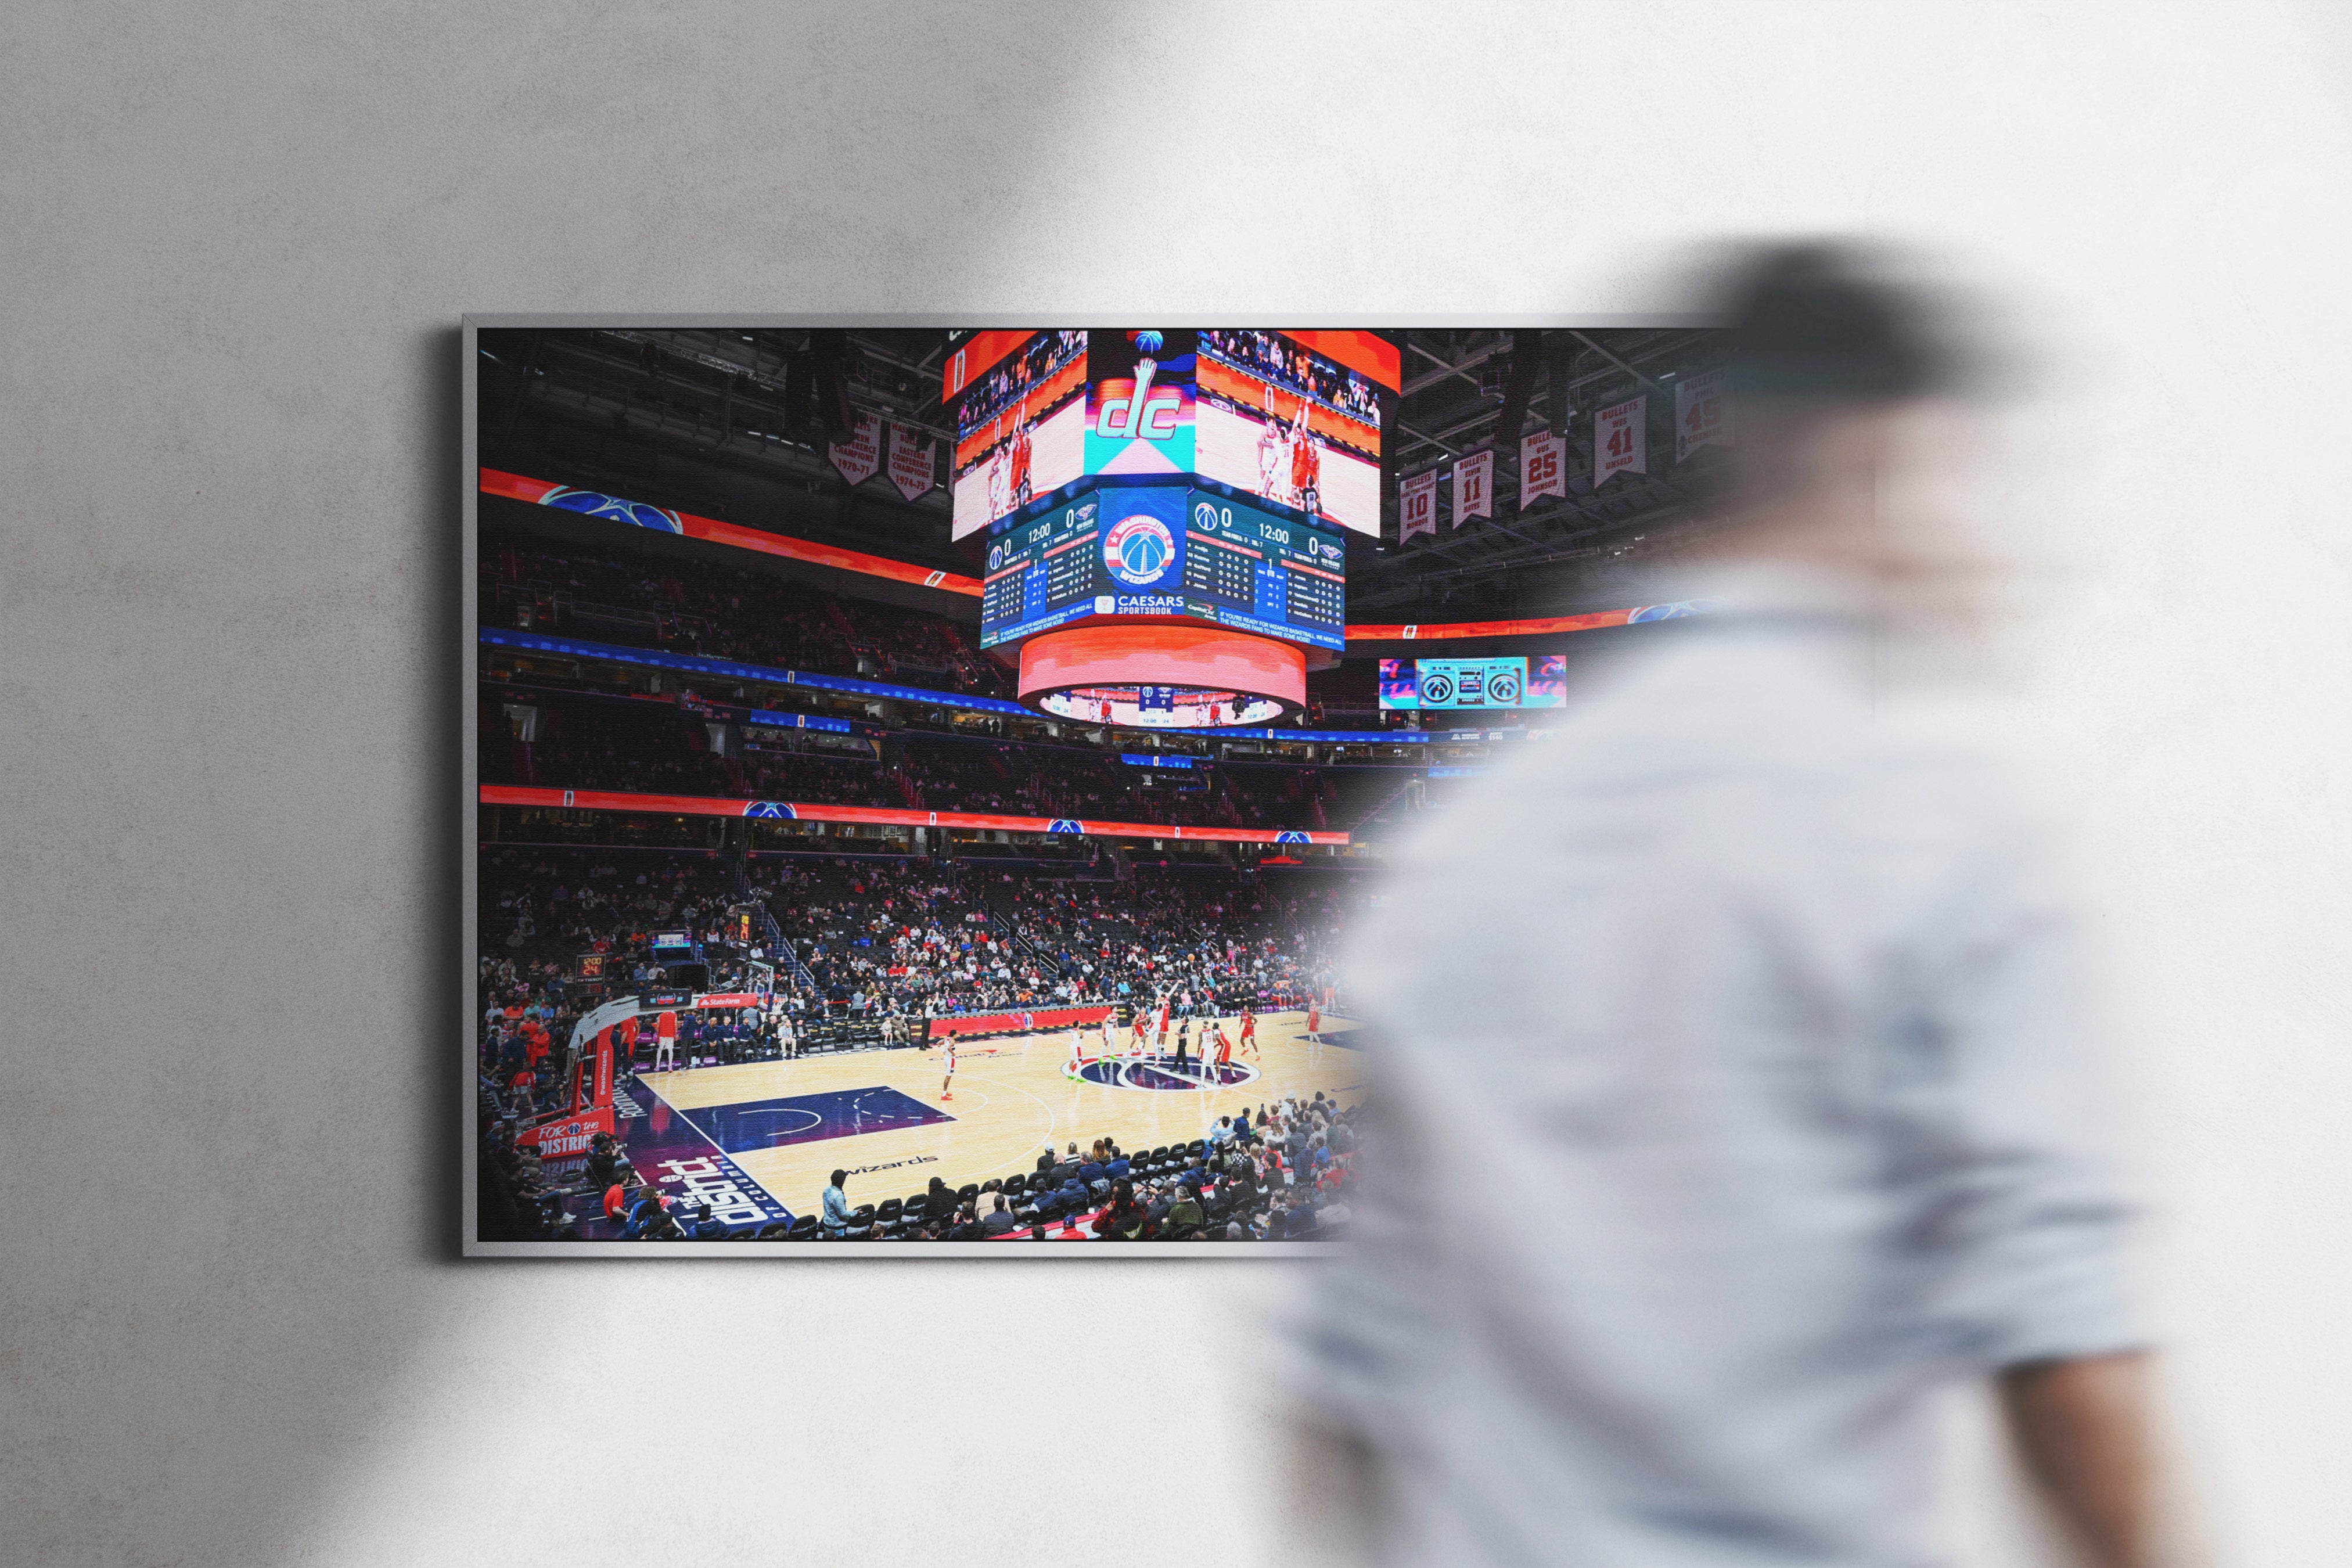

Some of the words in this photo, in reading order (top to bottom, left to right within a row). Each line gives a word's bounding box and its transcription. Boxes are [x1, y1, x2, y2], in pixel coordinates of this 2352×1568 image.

[1096, 357, 1181, 440] dc
[1602, 401, 1638, 420] BULLETS
[1685, 396, 1721, 431] 45
[1612, 418, 1627, 428] WES
[1527, 431, 1551, 447] BULLE
[1607, 426, 1632, 457] 41
[834, 446, 874, 463] CHAMPIONS
[900, 446, 926, 460] EASTERN
[1536, 444, 1549, 454] GUS
[838, 458, 869, 476] 1970-71
[892, 454, 932, 470] CONFERENCE
[1459, 453, 1487, 470] BULLETS
[1529, 451, 1557, 483] 25
[1605, 455, 1634, 470] UNSELD
[893, 462, 930, 479] CHAMPIONS
[1465, 466, 1481, 477] ELVIN
[896, 475, 925, 491] 1974-75
[1405, 473, 1431, 489] BULLETS
[1464, 476, 1480, 503] 11
[1527, 479, 1558, 494] JOHNSON
[1407, 493, 1427, 520] 10
[1464, 502, 1480, 513] HAYES
[1066, 509, 1074, 528] 0
[1221, 508, 1232, 527] 0
[1407, 517, 1428, 530] MONROE
[1028, 523, 1050, 544] 12:00
[1114, 516, 1170, 537] WASHINGTON
[1260, 523, 1289, 544] 12:00
[1005, 538, 1011, 556] 0
[1309, 537, 1318, 555] 0
[1268, 558, 1272, 569] 1
[1120, 569, 1164, 585] WIZARDS
[1118, 596, 1184, 607] CAESARS
[1225, 613, 1242, 621] YOU'RE
[1243, 617, 1259, 625] READY
[1269, 623, 1289, 632] WIZARDS
[1289, 628, 1315, 639] BASKETBALL,
[1230, 619, 1251, 629] WIZARDS
[1251, 624, 1263, 632] FANS
[583, 965, 598, 975] 24
[600, 1050, 608, 1095] @washwizards
[538, 1125, 567, 1139] FOR
[539, 1133, 596, 1156] DISTRIC
[846, 1156, 938, 1176] wizards
[677, 1196, 703, 1210] THE
[765, 1206, 787, 1218] OF
